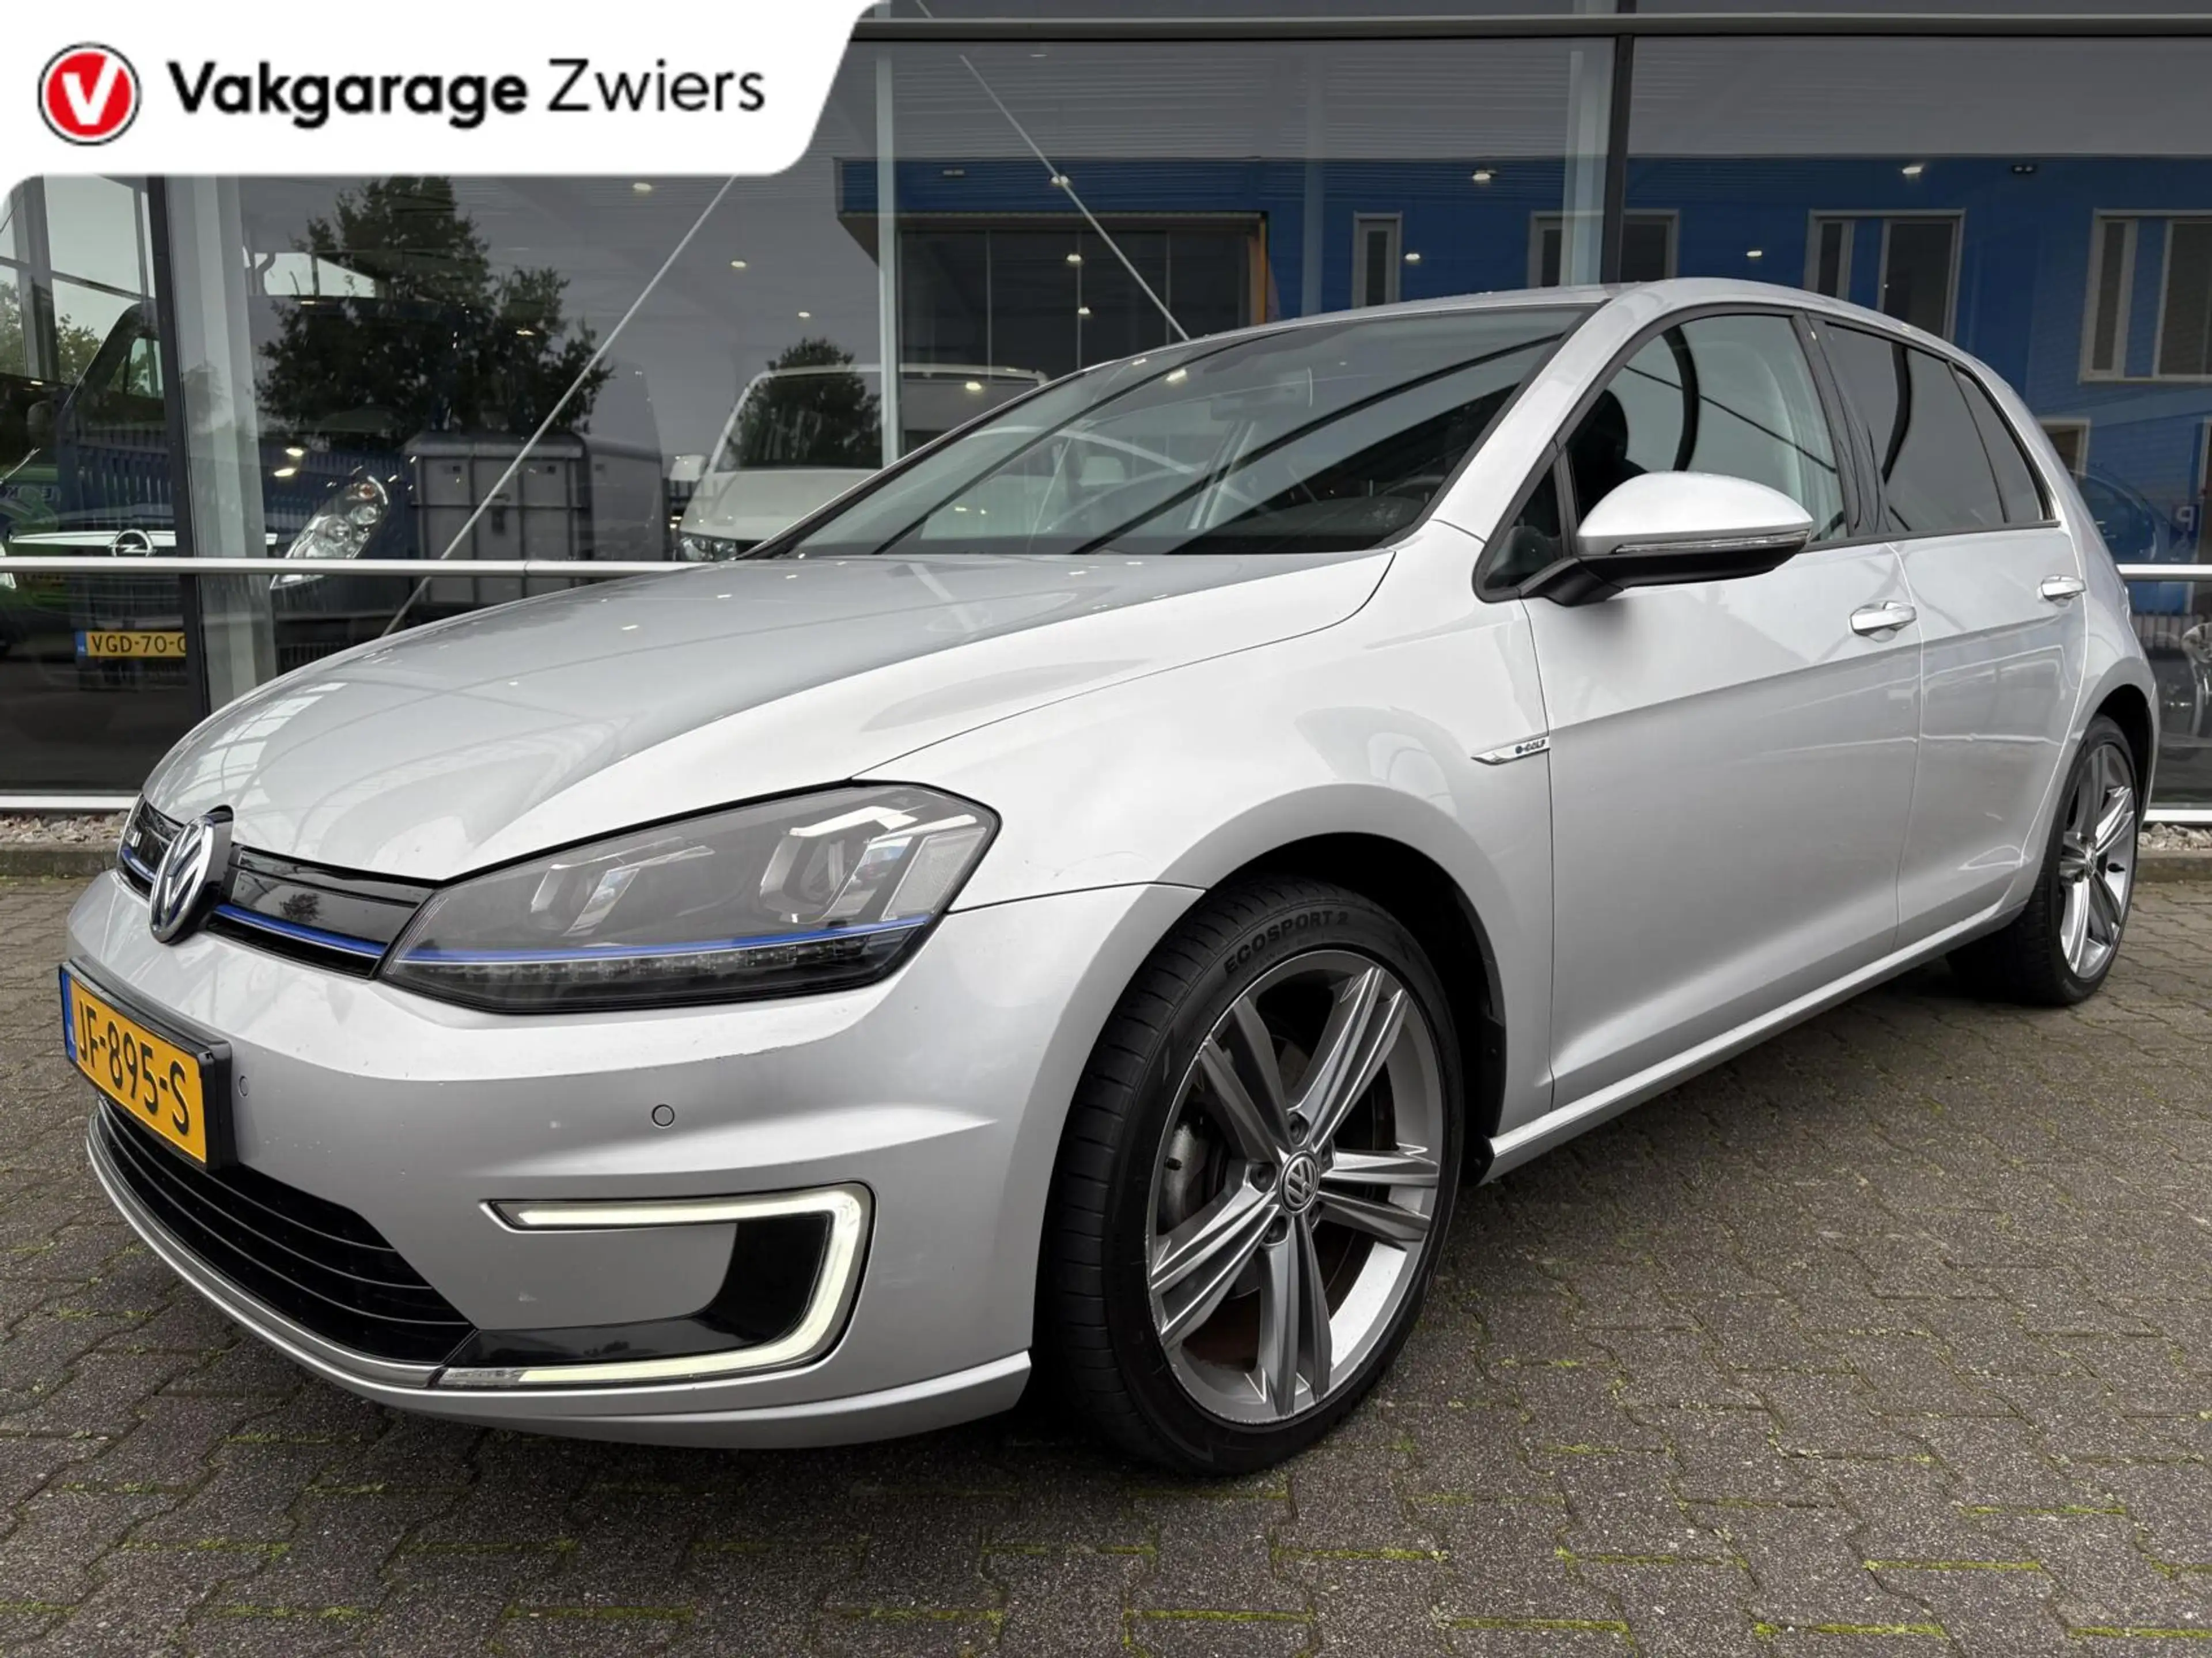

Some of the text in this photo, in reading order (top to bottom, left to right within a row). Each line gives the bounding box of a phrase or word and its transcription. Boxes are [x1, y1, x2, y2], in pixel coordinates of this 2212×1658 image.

[1223, 910, 1334, 974] ECOSPORT
[1338, 911, 1349, 925] 2
[78, 998, 190, 1136] JF-895-S
